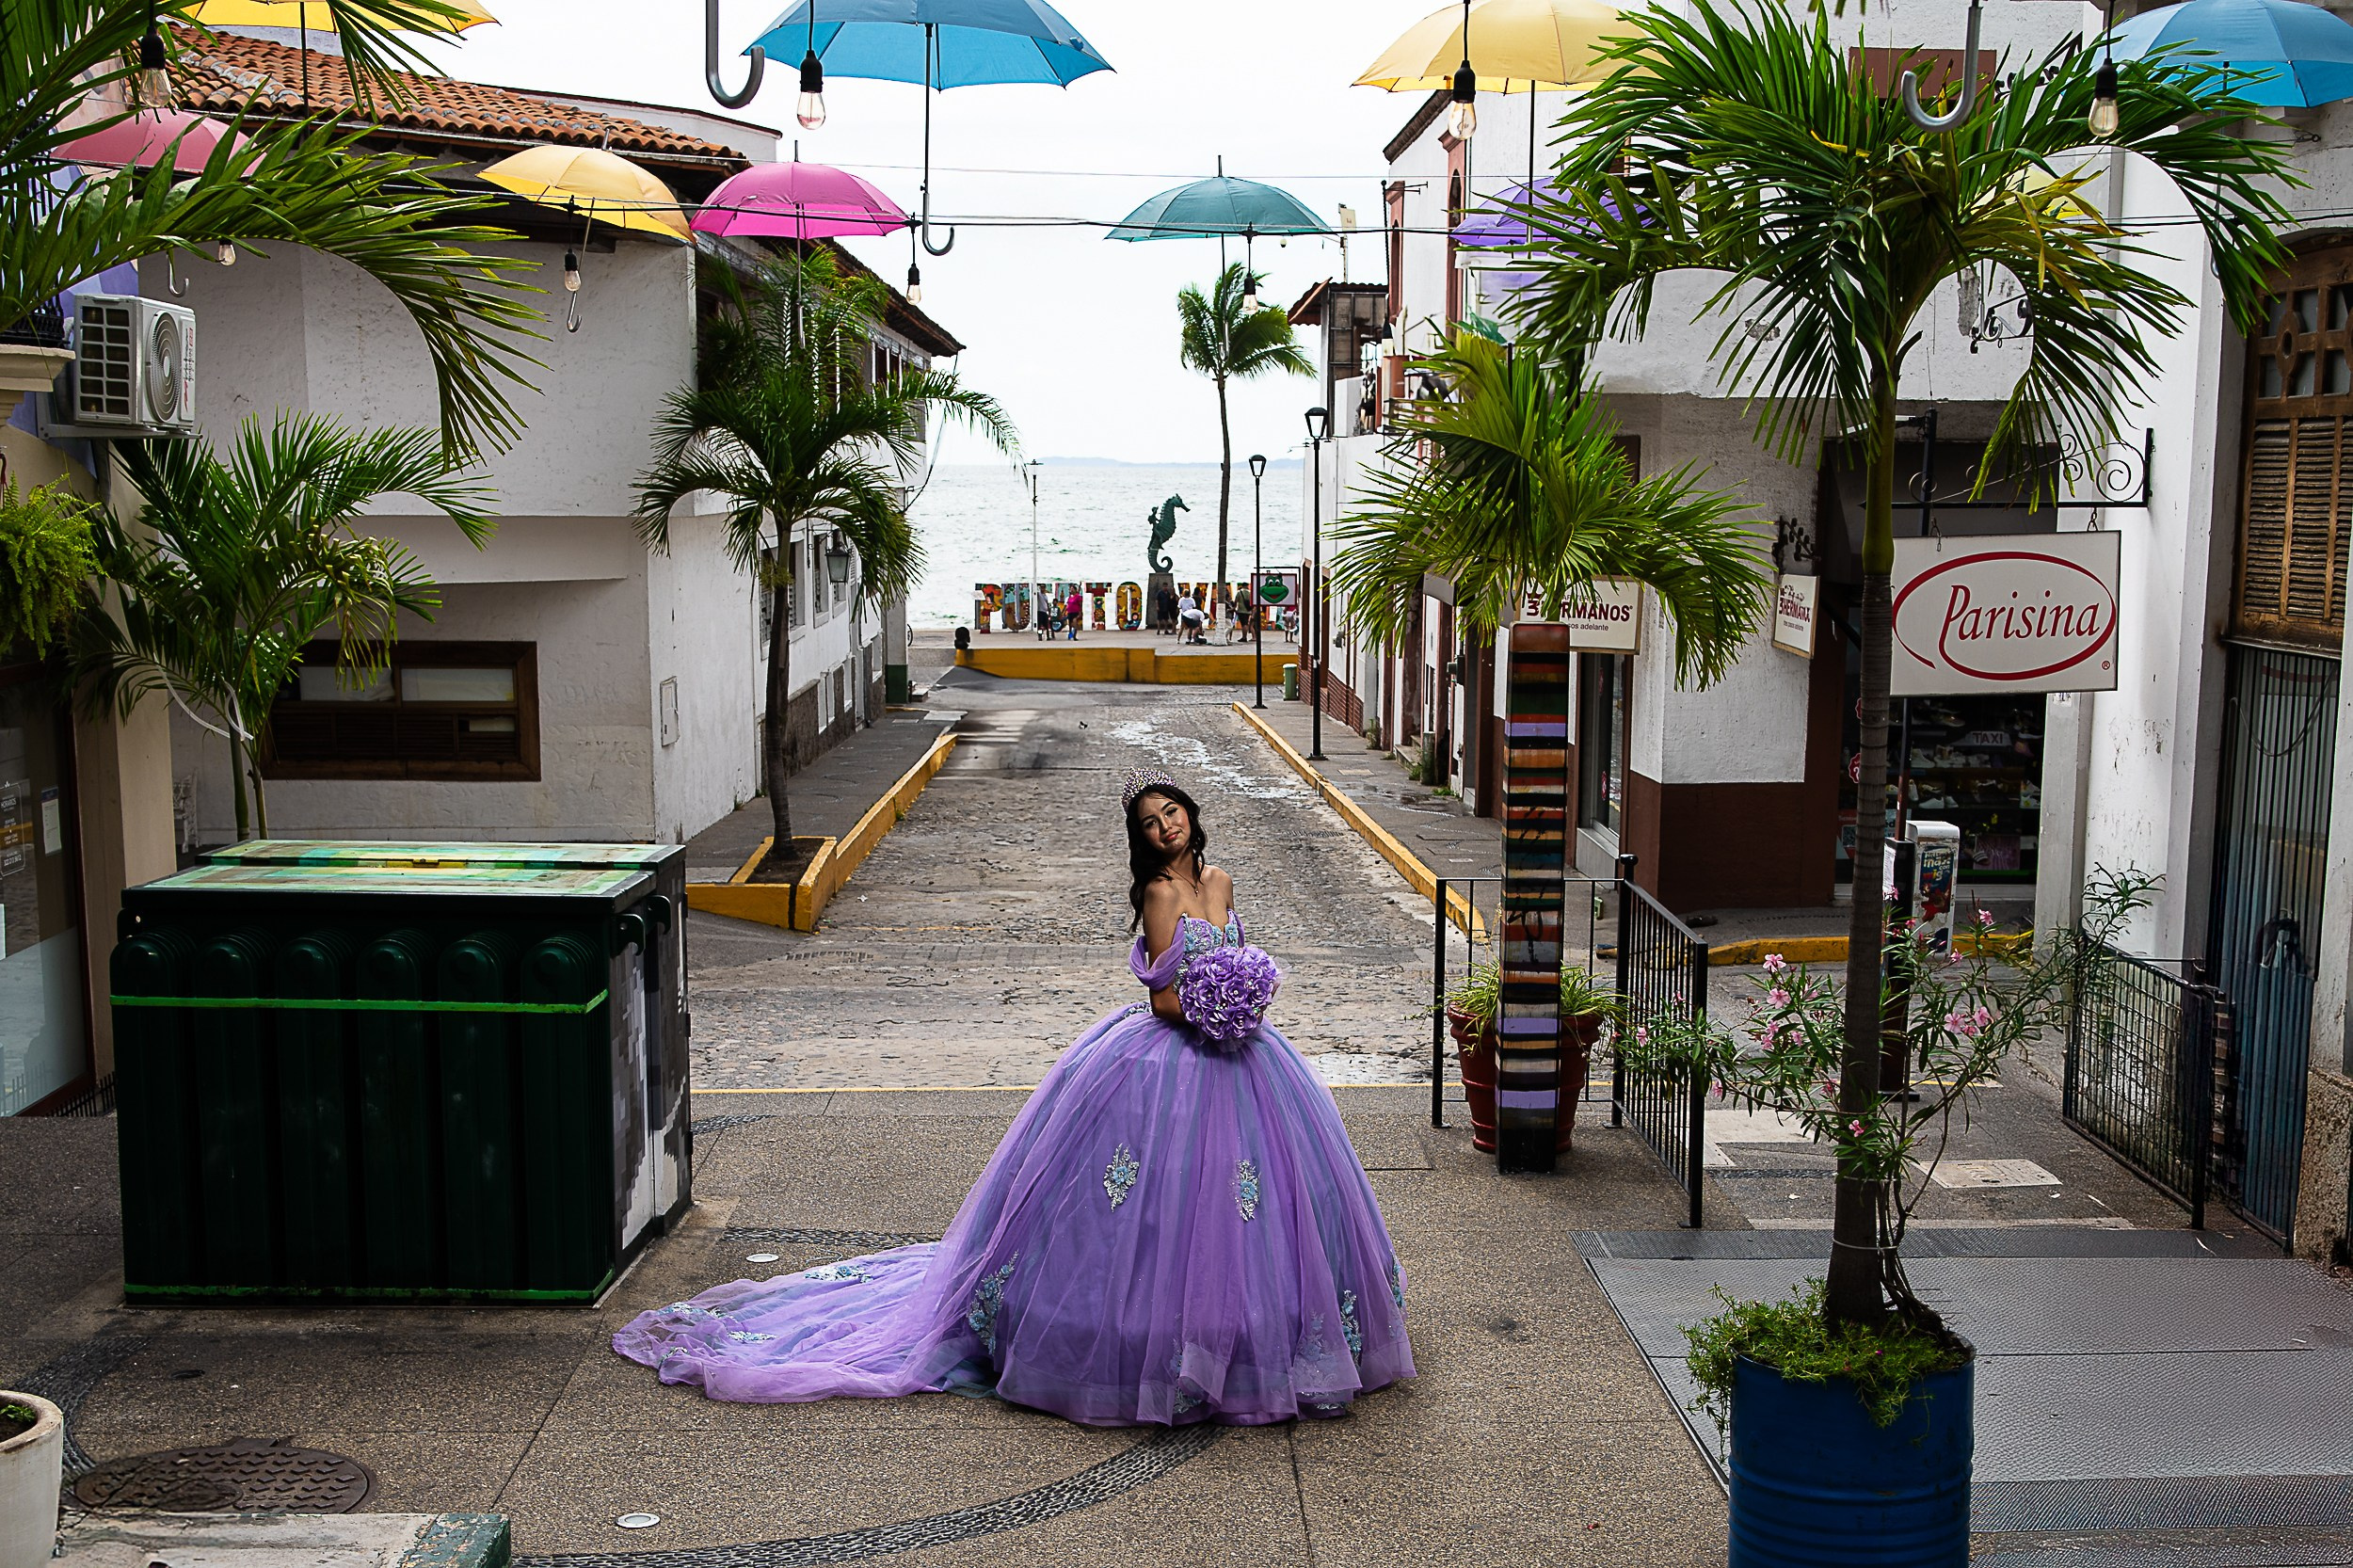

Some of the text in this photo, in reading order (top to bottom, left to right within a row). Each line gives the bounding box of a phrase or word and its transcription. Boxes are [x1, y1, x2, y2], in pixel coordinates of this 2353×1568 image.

[1941, 584, 2100, 641] Parisina
[1580, 622, 1609, 632] adelante
[1973, 732, 2003, 744] TAXI
